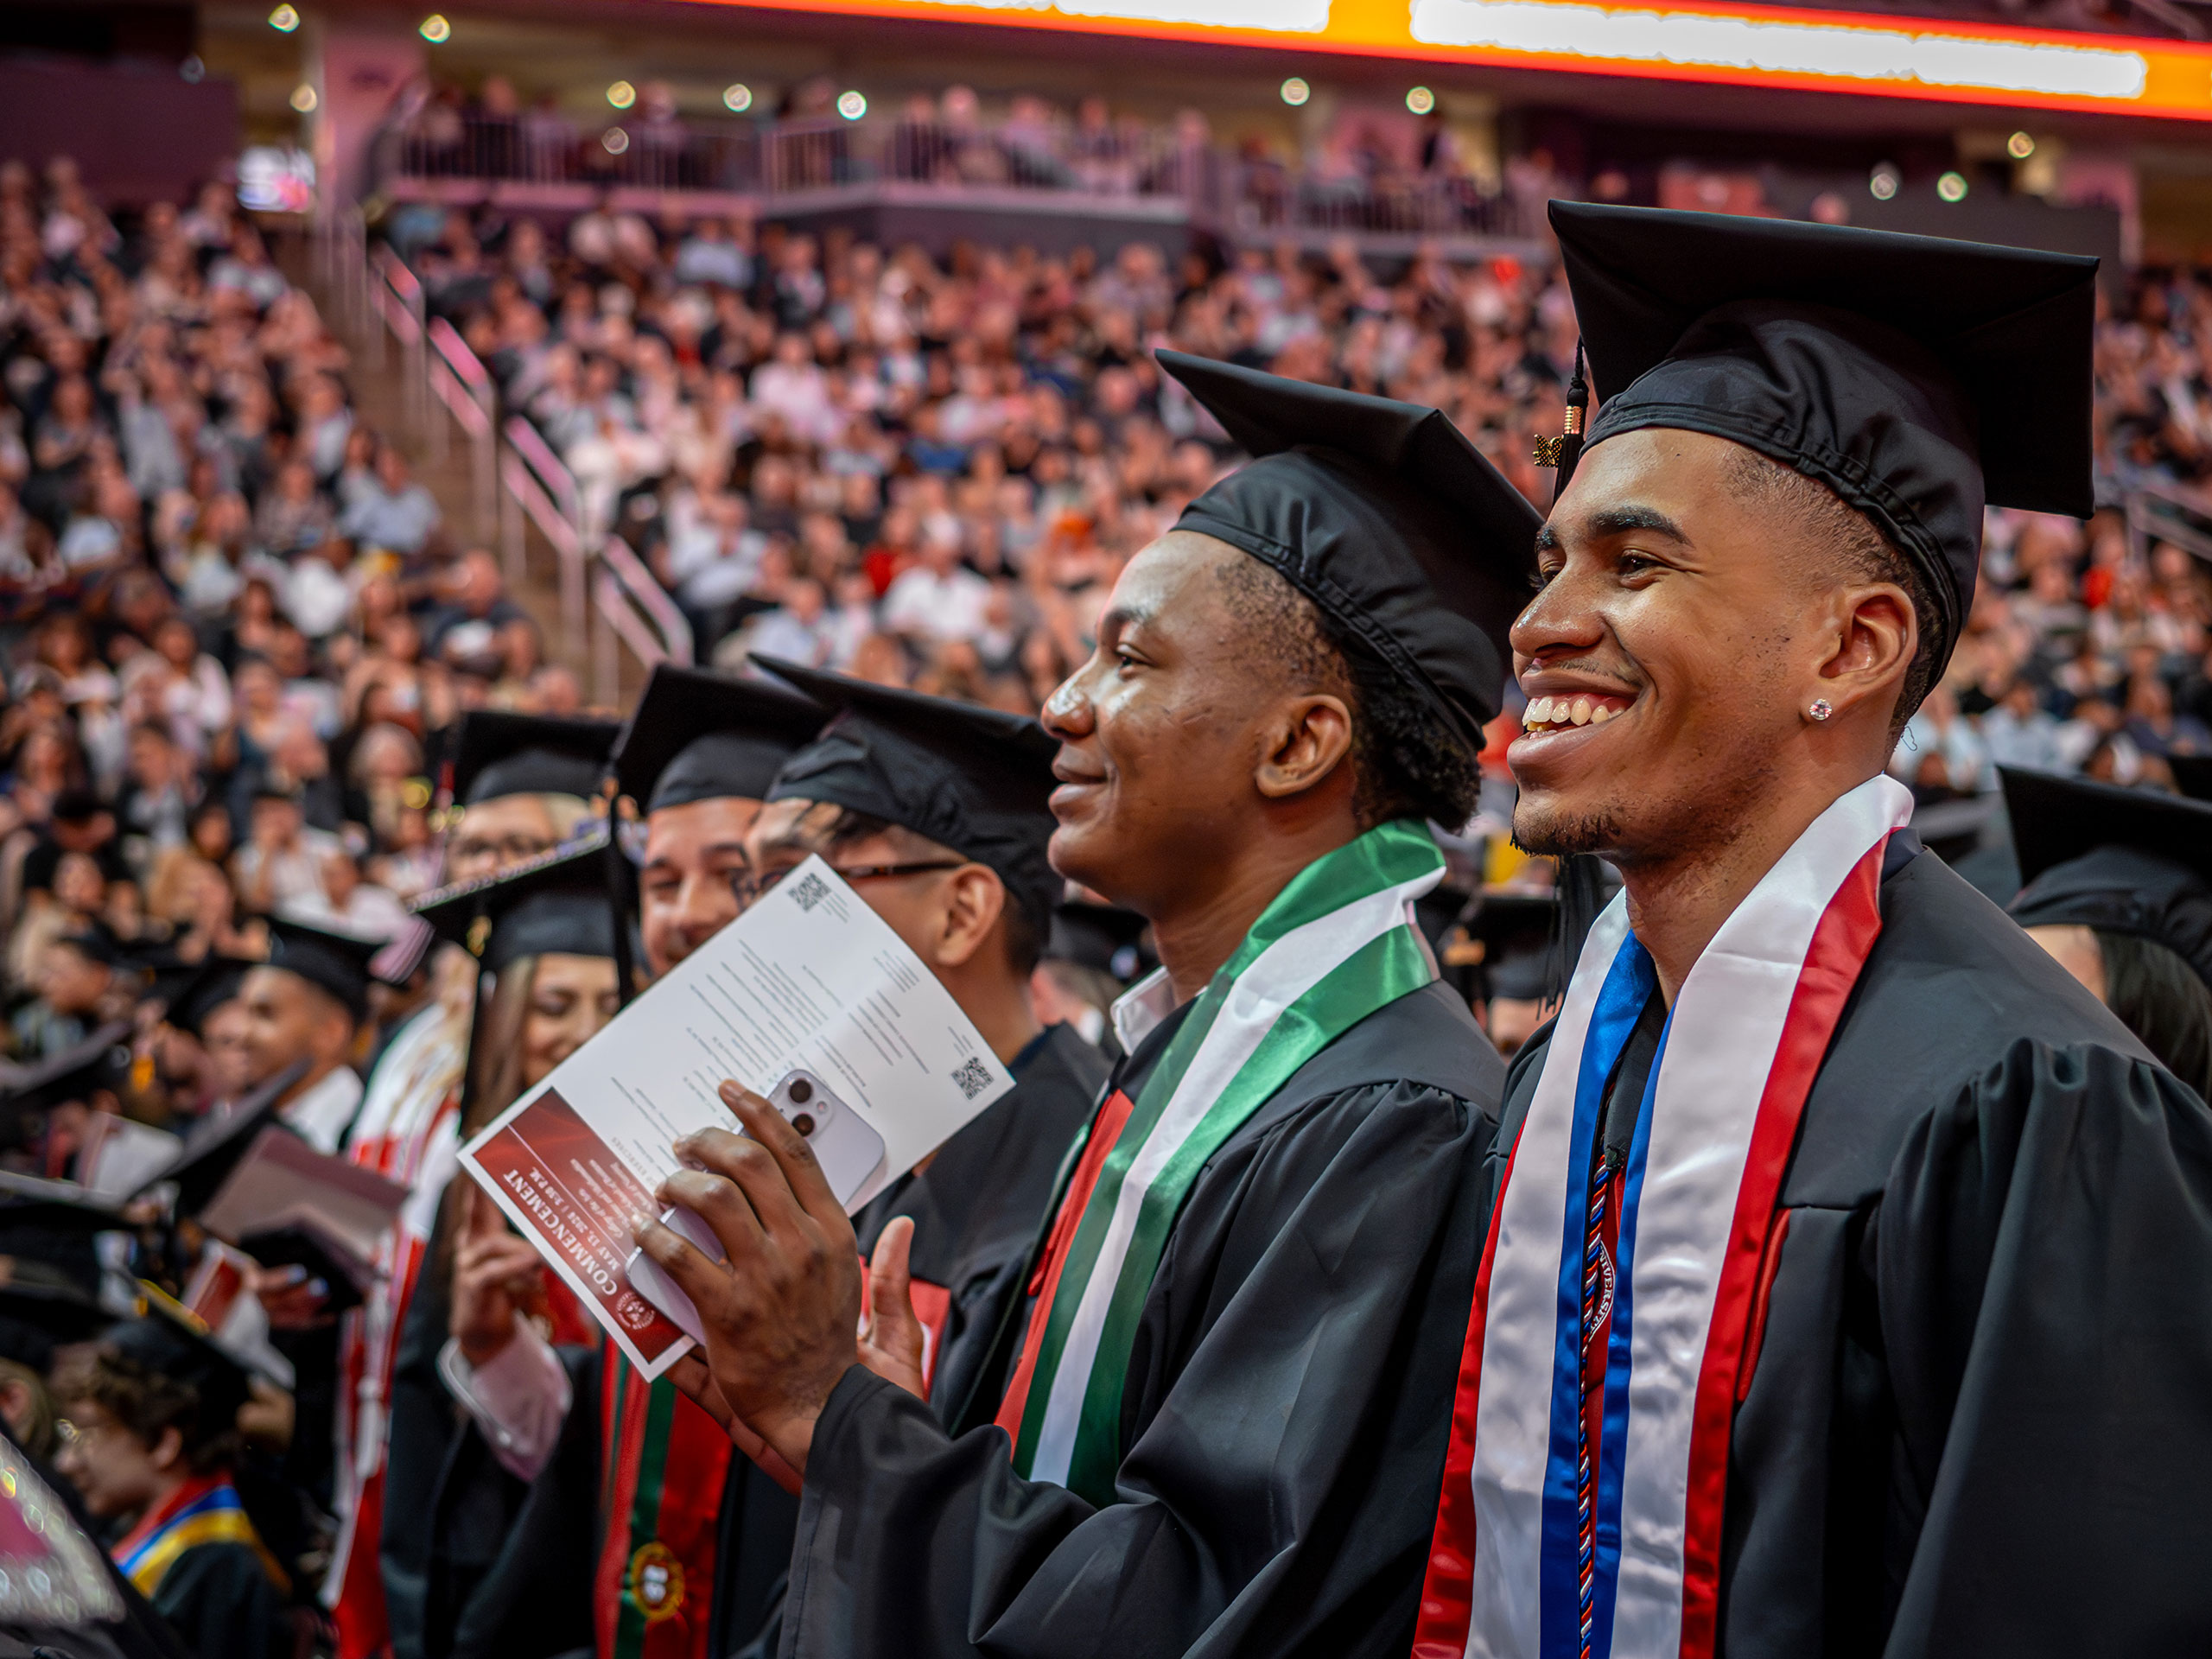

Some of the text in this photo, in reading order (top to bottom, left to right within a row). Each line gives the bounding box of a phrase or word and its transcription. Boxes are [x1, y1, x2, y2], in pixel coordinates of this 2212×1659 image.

[502, 1166, 620, 1297] COMMENCEMENT
[583, 1230, 601, 1247] 13,
[596, 1244, 620, 1270] MAY
